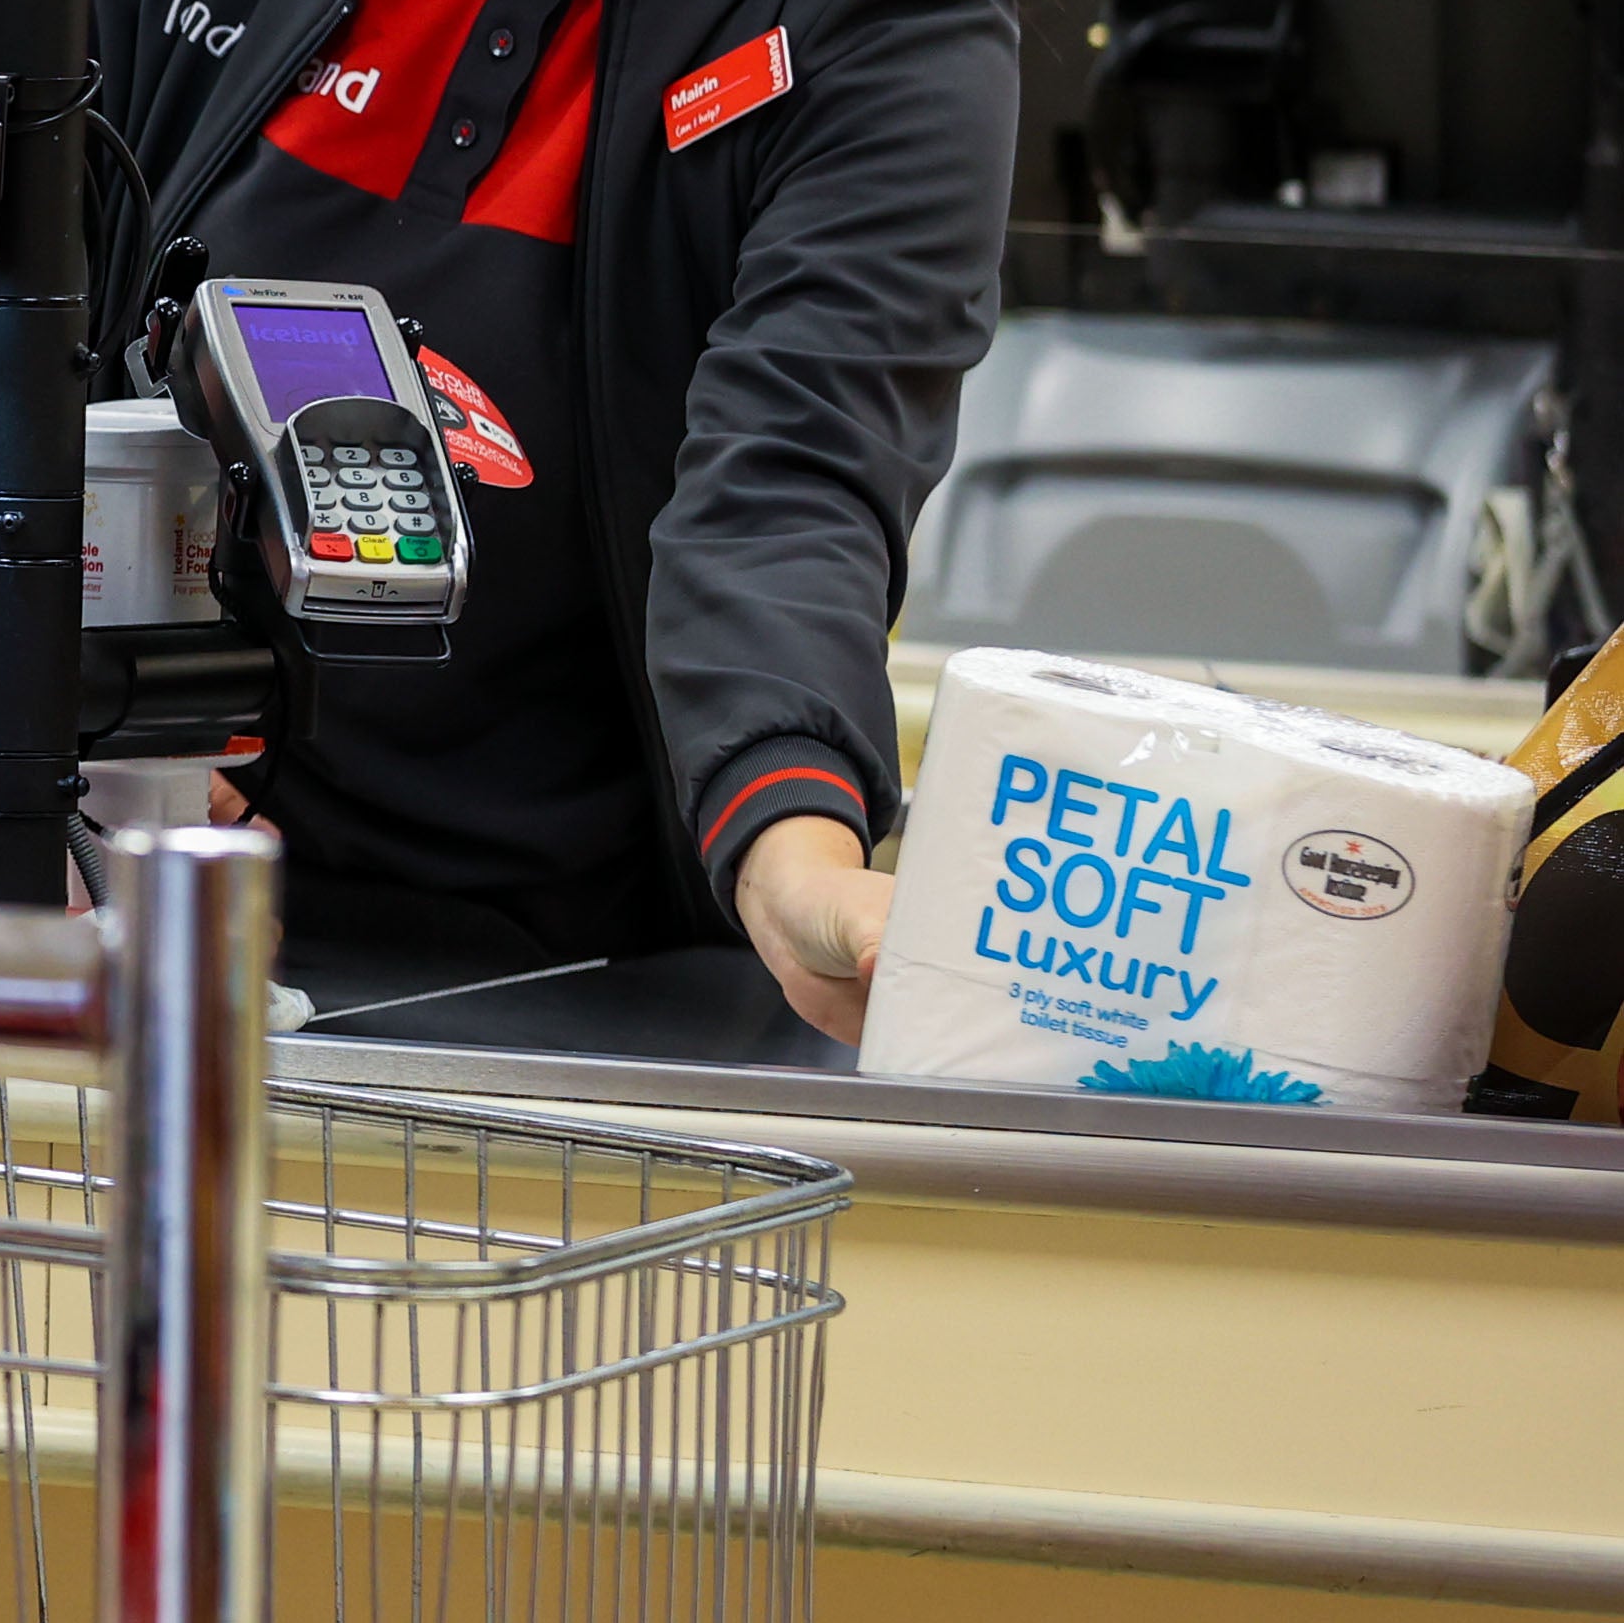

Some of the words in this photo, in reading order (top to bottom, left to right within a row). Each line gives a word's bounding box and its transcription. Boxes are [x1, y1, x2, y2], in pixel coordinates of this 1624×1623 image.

[345, 449, 358, 460] 2
[393, 451, 405, 462] 3
[352, 470, 363, 481] 5
[399, 472, 410, 483] 6
[359, 492, 370, 503] 8
[405, 494, 416, 505] 9
[365, 514, 376, 526] 0
[991, 754, 1251, 887] PETAL
[996, 836, 1227, 956] SOFT
[974, 905, 1219, 1022] Luxury
[1009, 982, 1021, 998] 3
[1024, 988, 1053, 1011] ply
[1055, 997, 1094, 1019] soft
[1096, 1007, 1149, 1031] white
[1019, 1007, 1069, 1034] toilet
[1071, 1020, 1129, 1049] tissue
